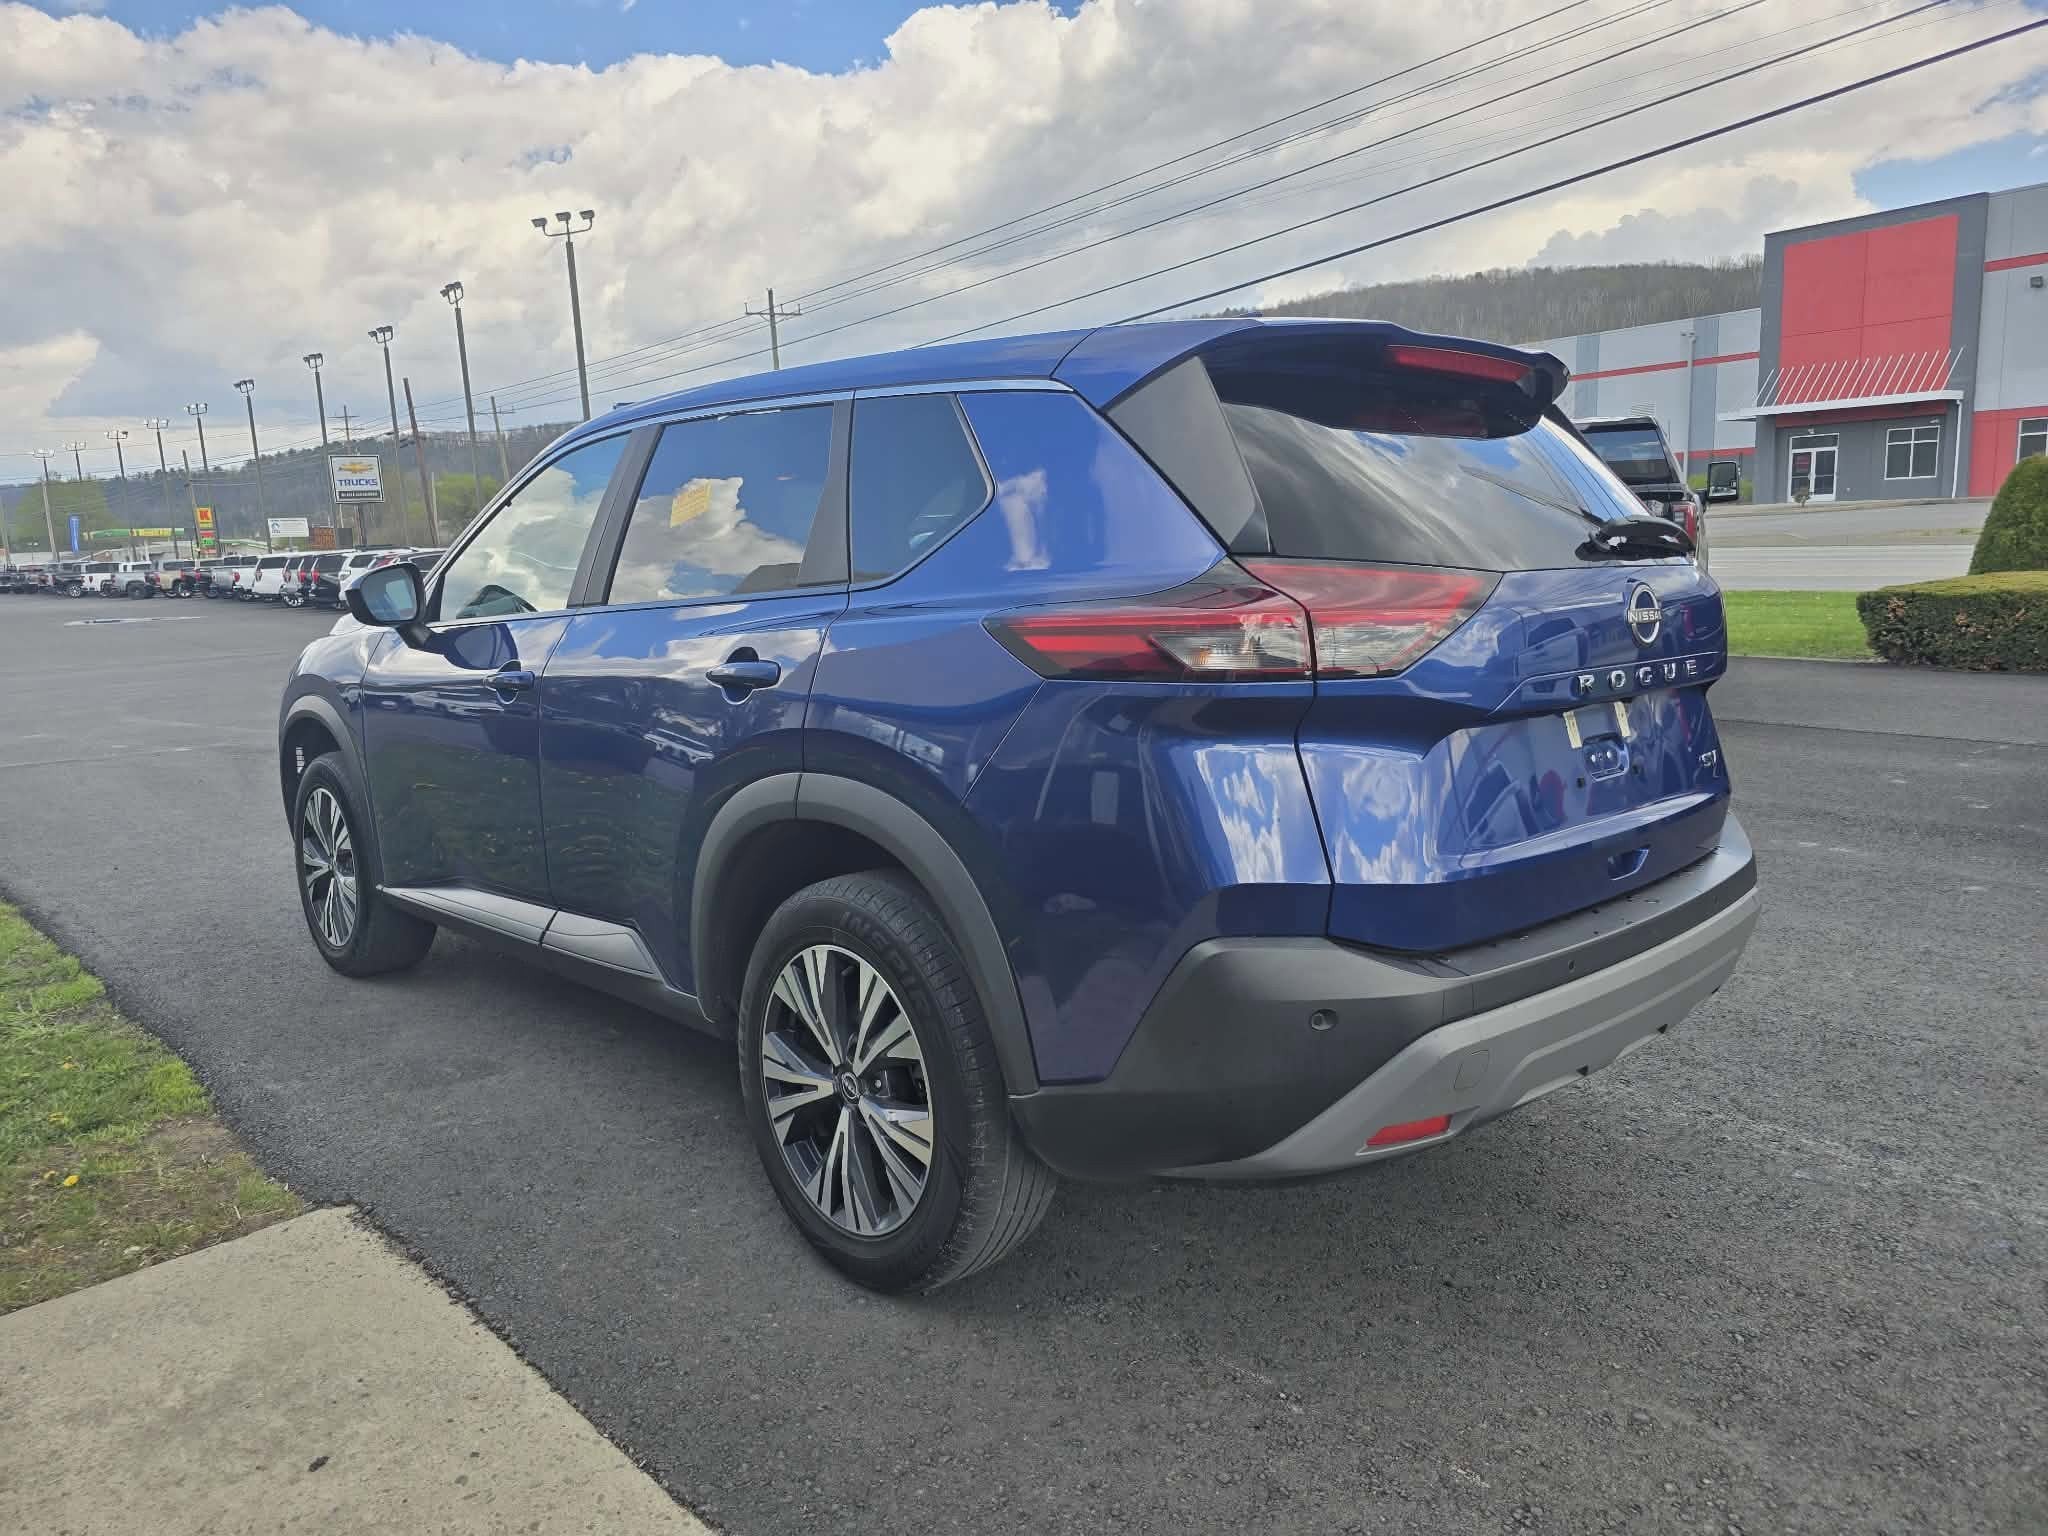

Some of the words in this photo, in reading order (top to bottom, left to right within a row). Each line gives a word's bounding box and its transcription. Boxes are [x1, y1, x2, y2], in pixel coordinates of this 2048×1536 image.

[338, 478, 377, 487] TRUCKS
[1629, 609, 1662, 621] NISSAN
[1578, 660, 1697, 693] ROGUE
